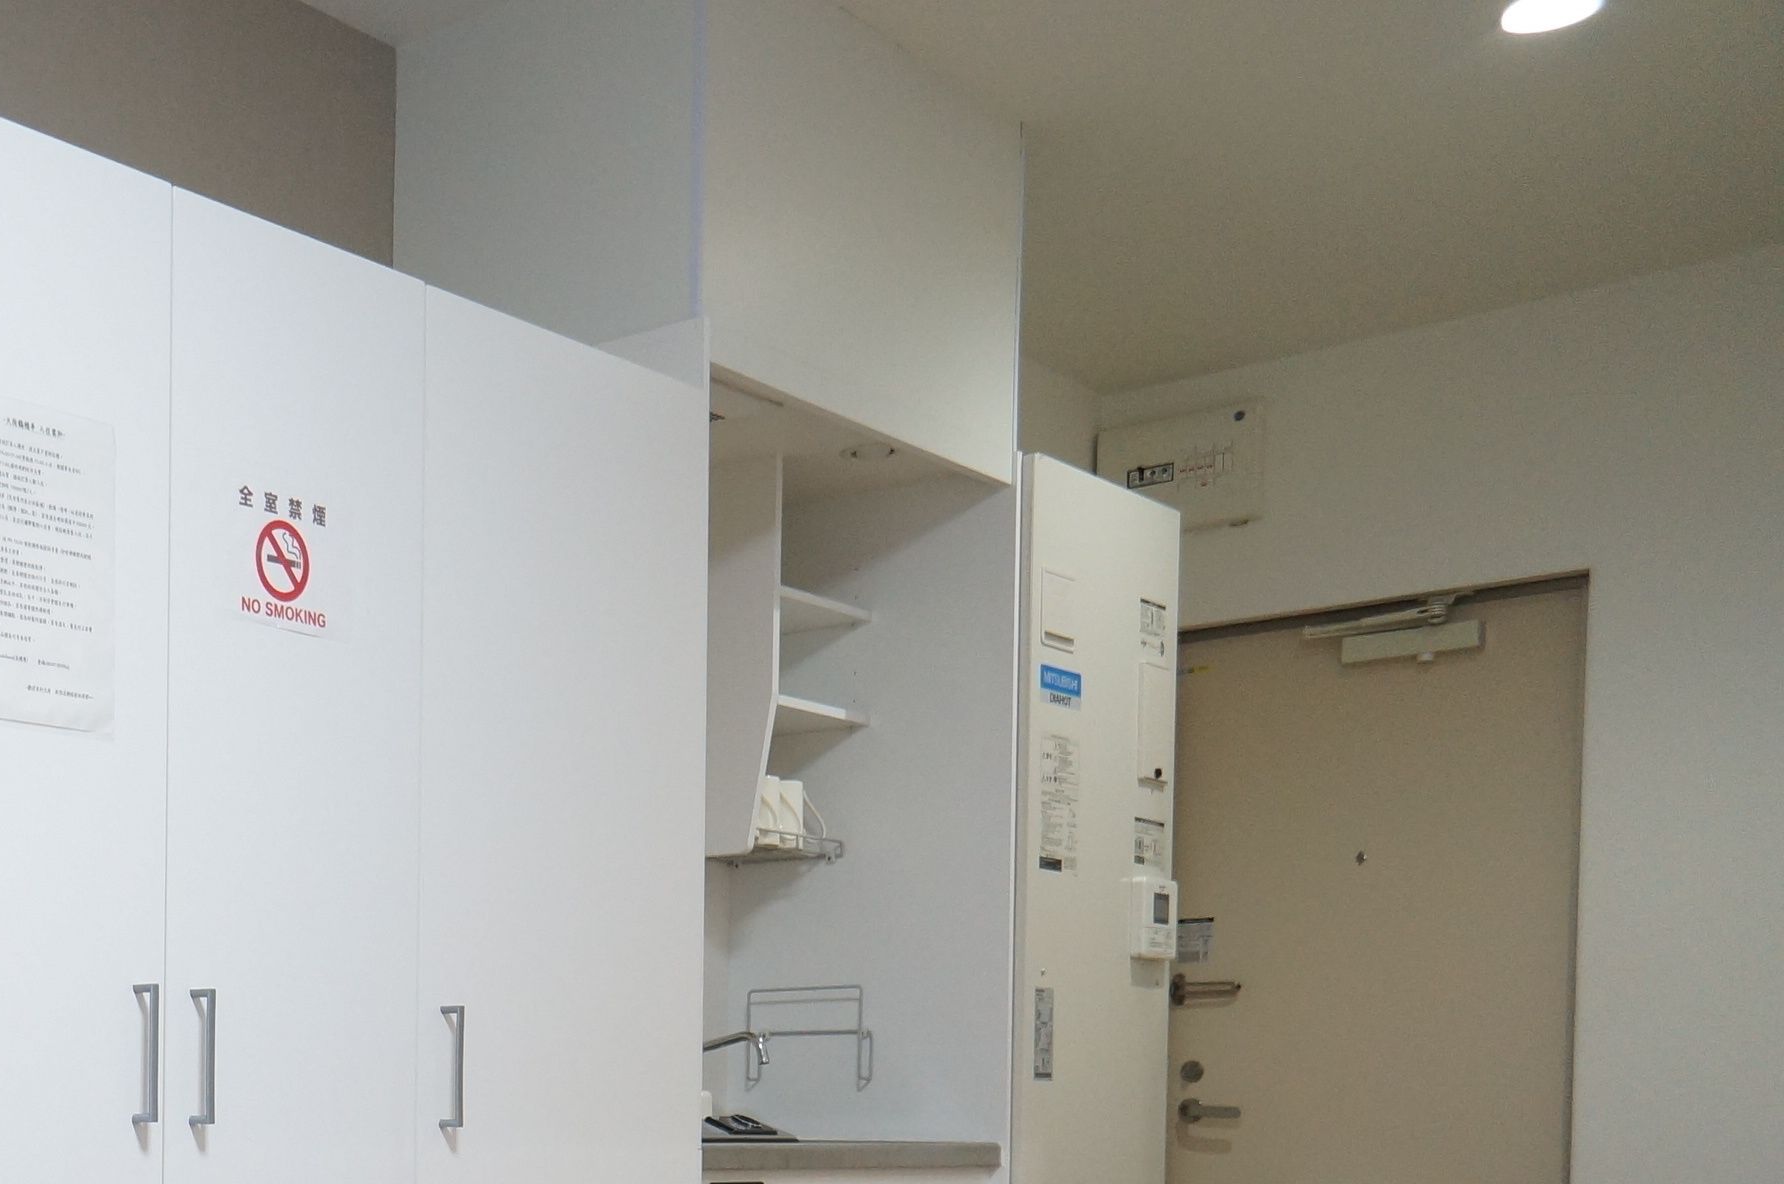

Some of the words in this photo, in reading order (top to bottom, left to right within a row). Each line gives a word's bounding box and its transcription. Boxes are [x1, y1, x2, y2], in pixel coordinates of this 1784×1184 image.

[239, 485, 327, 528] 全室禁煙
[241, 596, 262, 614] NO
[265, 602, 327, 628] SMOKING
